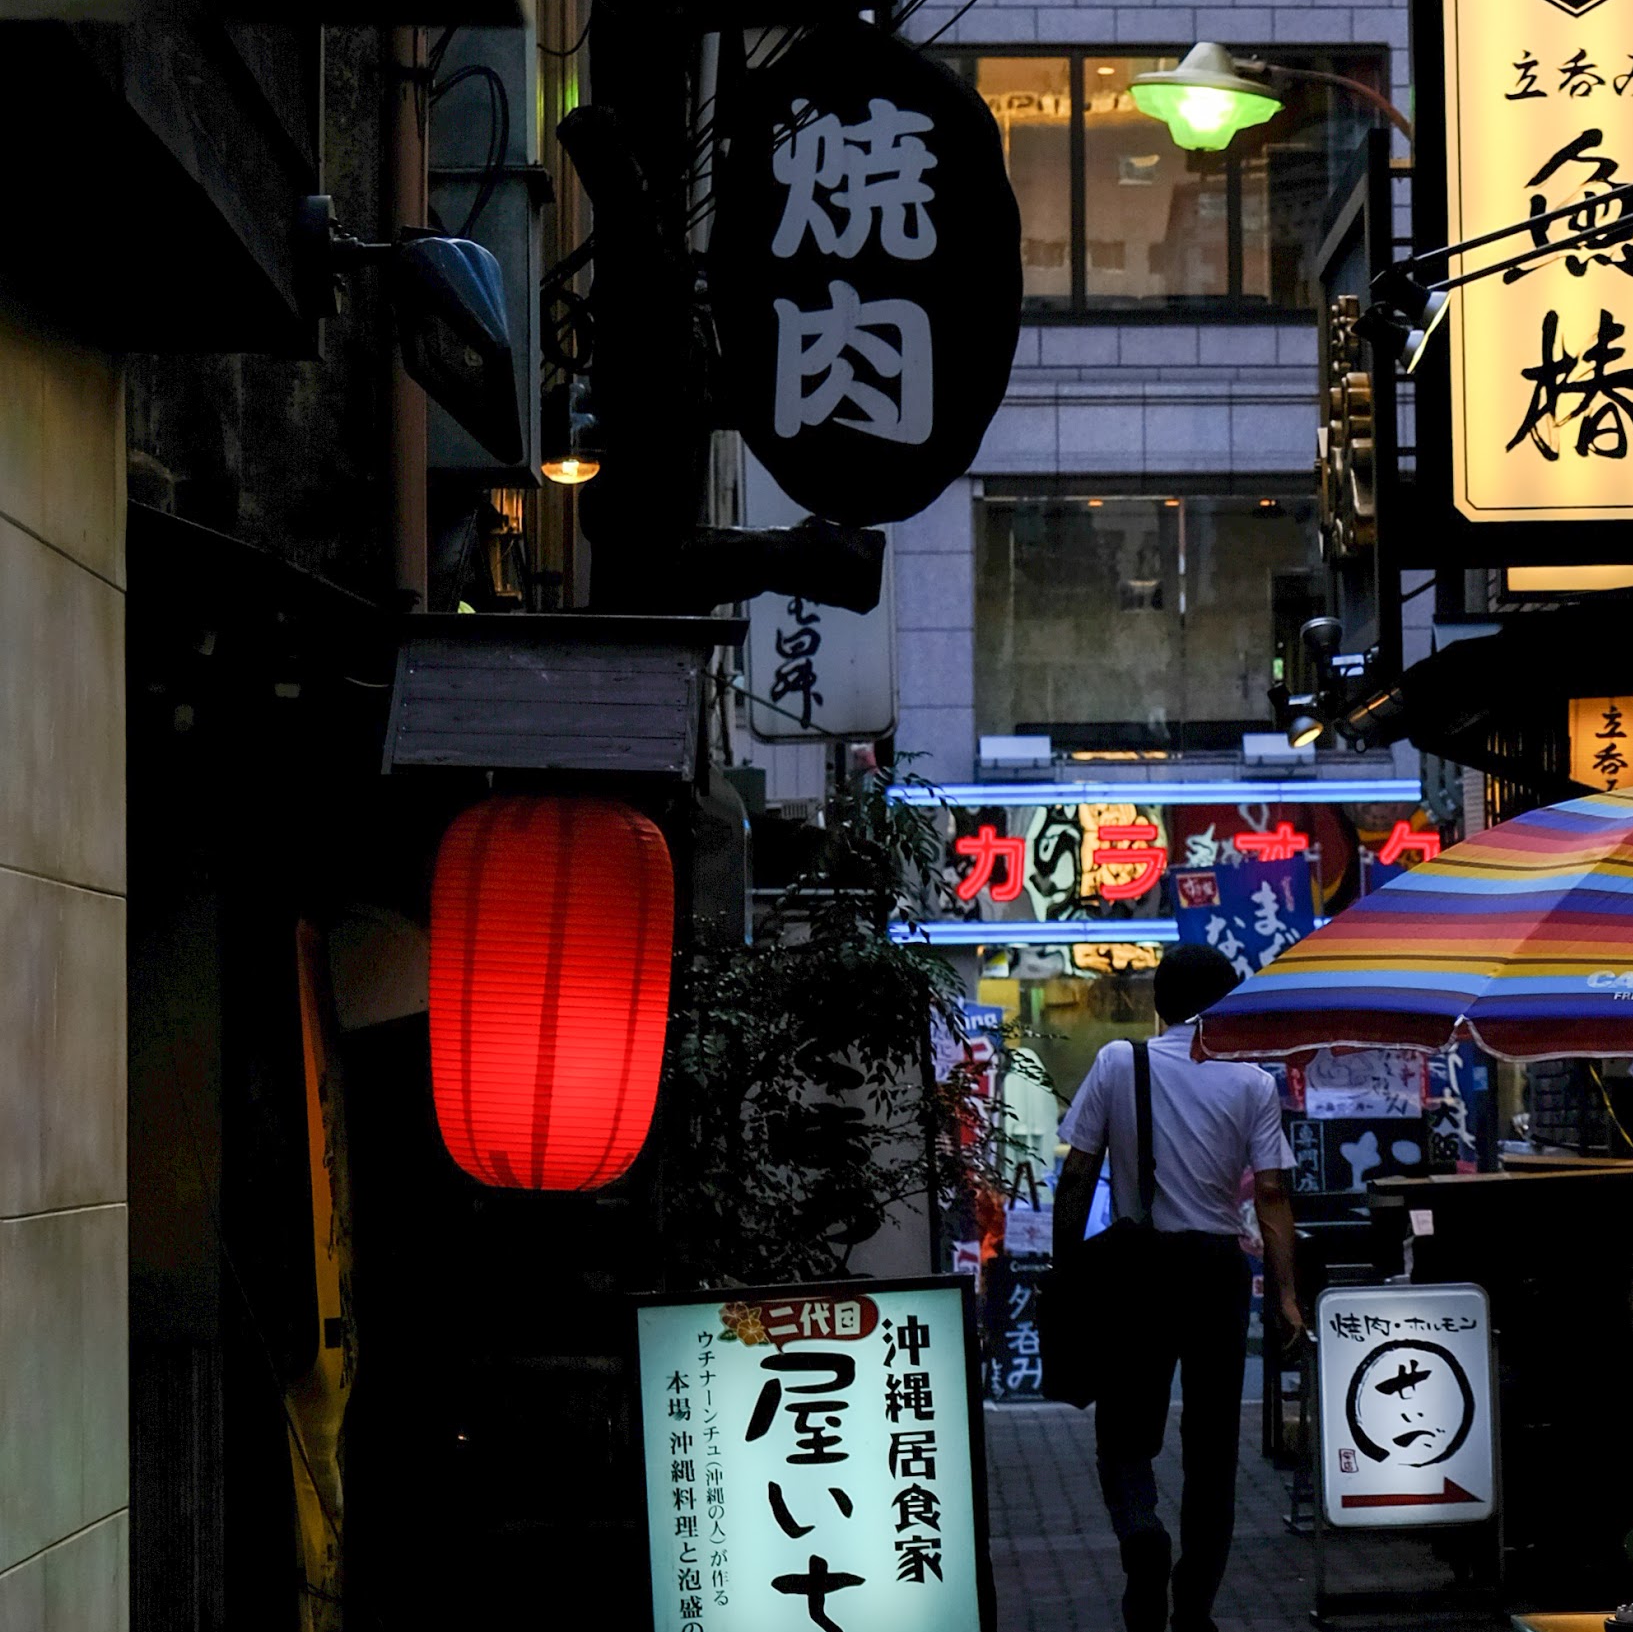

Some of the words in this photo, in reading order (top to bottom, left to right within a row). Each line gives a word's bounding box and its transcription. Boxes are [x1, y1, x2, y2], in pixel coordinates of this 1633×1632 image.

[771, 96, 938, 448] 焼肉
[767, 1299, 862, 1337] 二代目
[1329, 1312, 1477, 1343] 焼肉・ホルモン
[881, 1314, 944, 1584] 沖縄居食家
